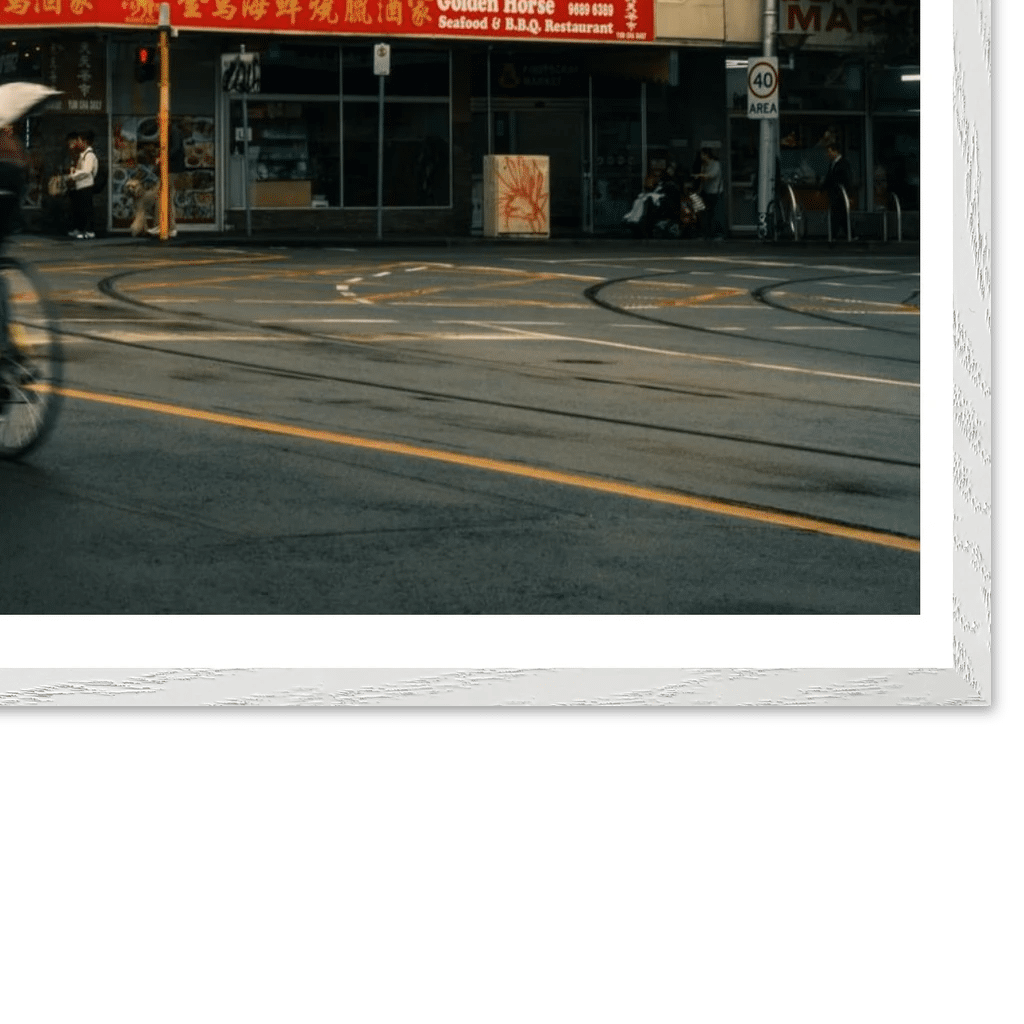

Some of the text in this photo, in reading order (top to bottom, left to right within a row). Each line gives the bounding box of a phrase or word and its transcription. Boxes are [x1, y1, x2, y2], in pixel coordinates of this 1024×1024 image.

[438, 15, 489, 30] Seafood
[544, 19, 615, 35] Restaurant
[753, 72, 773, 89] 40
[749, 102, 777, 114] AREA
